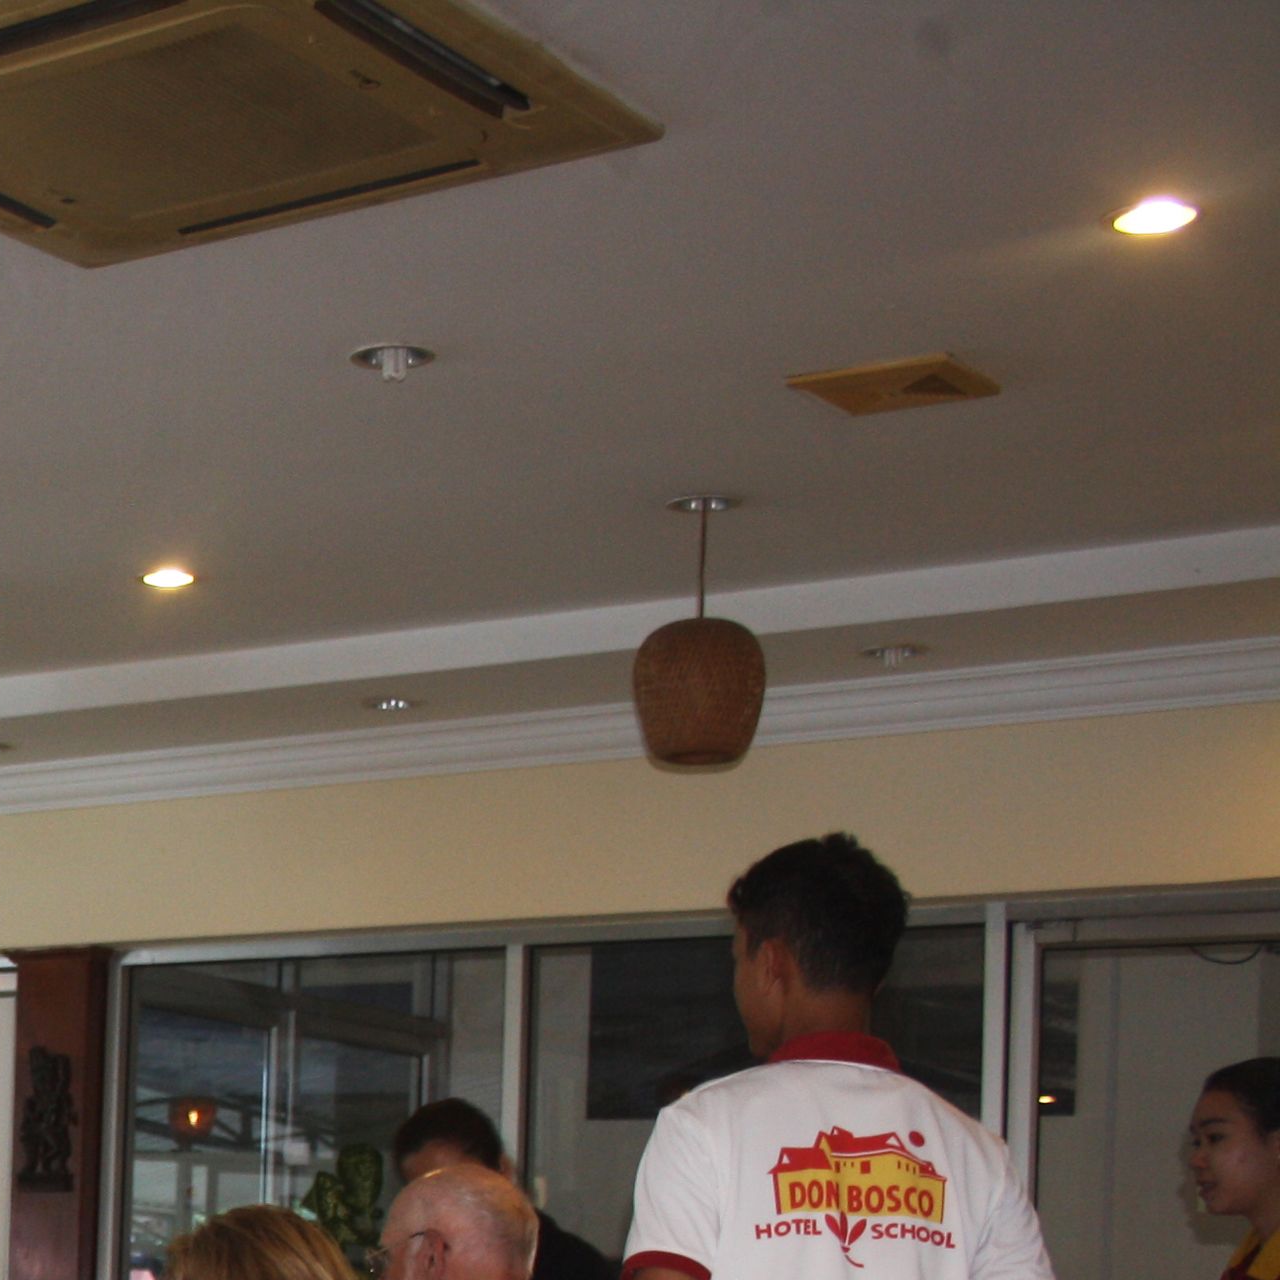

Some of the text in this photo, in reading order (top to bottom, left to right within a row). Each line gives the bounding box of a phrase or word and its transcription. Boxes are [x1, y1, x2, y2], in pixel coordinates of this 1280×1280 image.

[788, 1179, 934, 1218] DON BOSCO
[755, 1219, 955, 1248] HOTEL SCHOOL
